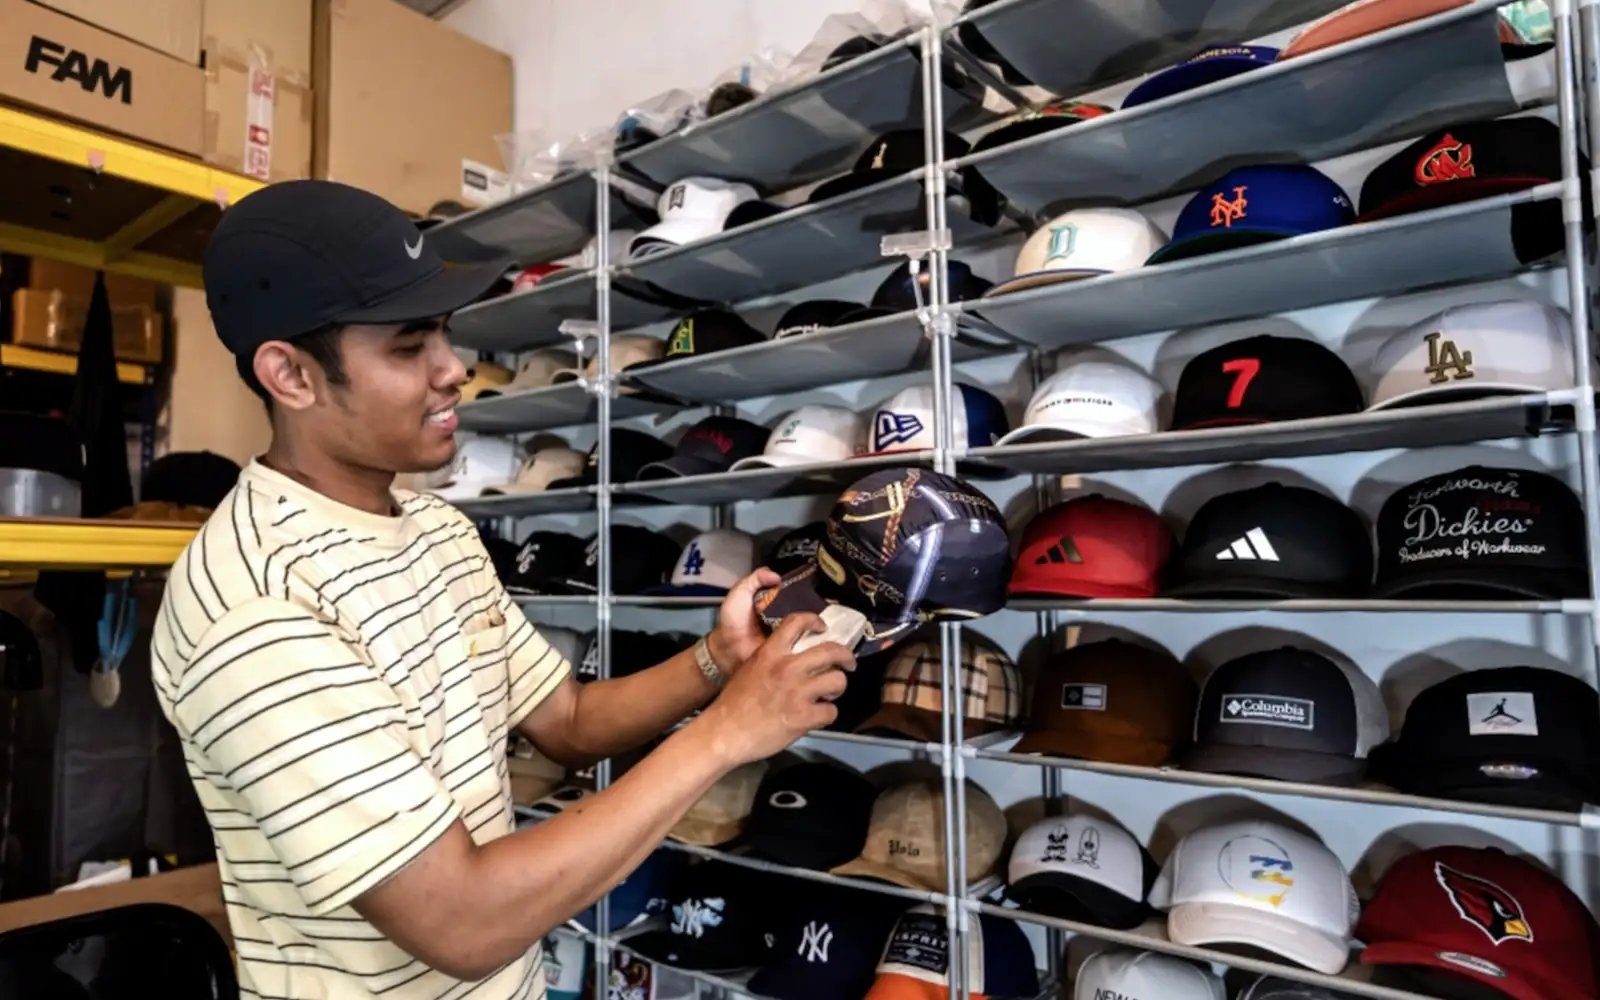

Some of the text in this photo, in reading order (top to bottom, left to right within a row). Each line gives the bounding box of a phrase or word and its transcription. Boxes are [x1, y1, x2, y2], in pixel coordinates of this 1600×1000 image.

[24, 35, 132, 104] FAM
[1044, 223, 1079, 261] D
[1423, 332, 1474, 384] LA
[1072, 397, 1113, 406] HILFIGER
[1222, 358, 1260, 408] 7
[1403, 504, 1527, 546] Dickies
[1455, 538, 1470, 560] of
[1471, 537, 1546, 555] Workwear
[1241, 699, 1304, 716] Columbia
[888, 840, 920, 857] Polo
[798, 920, 834, 963] NY
